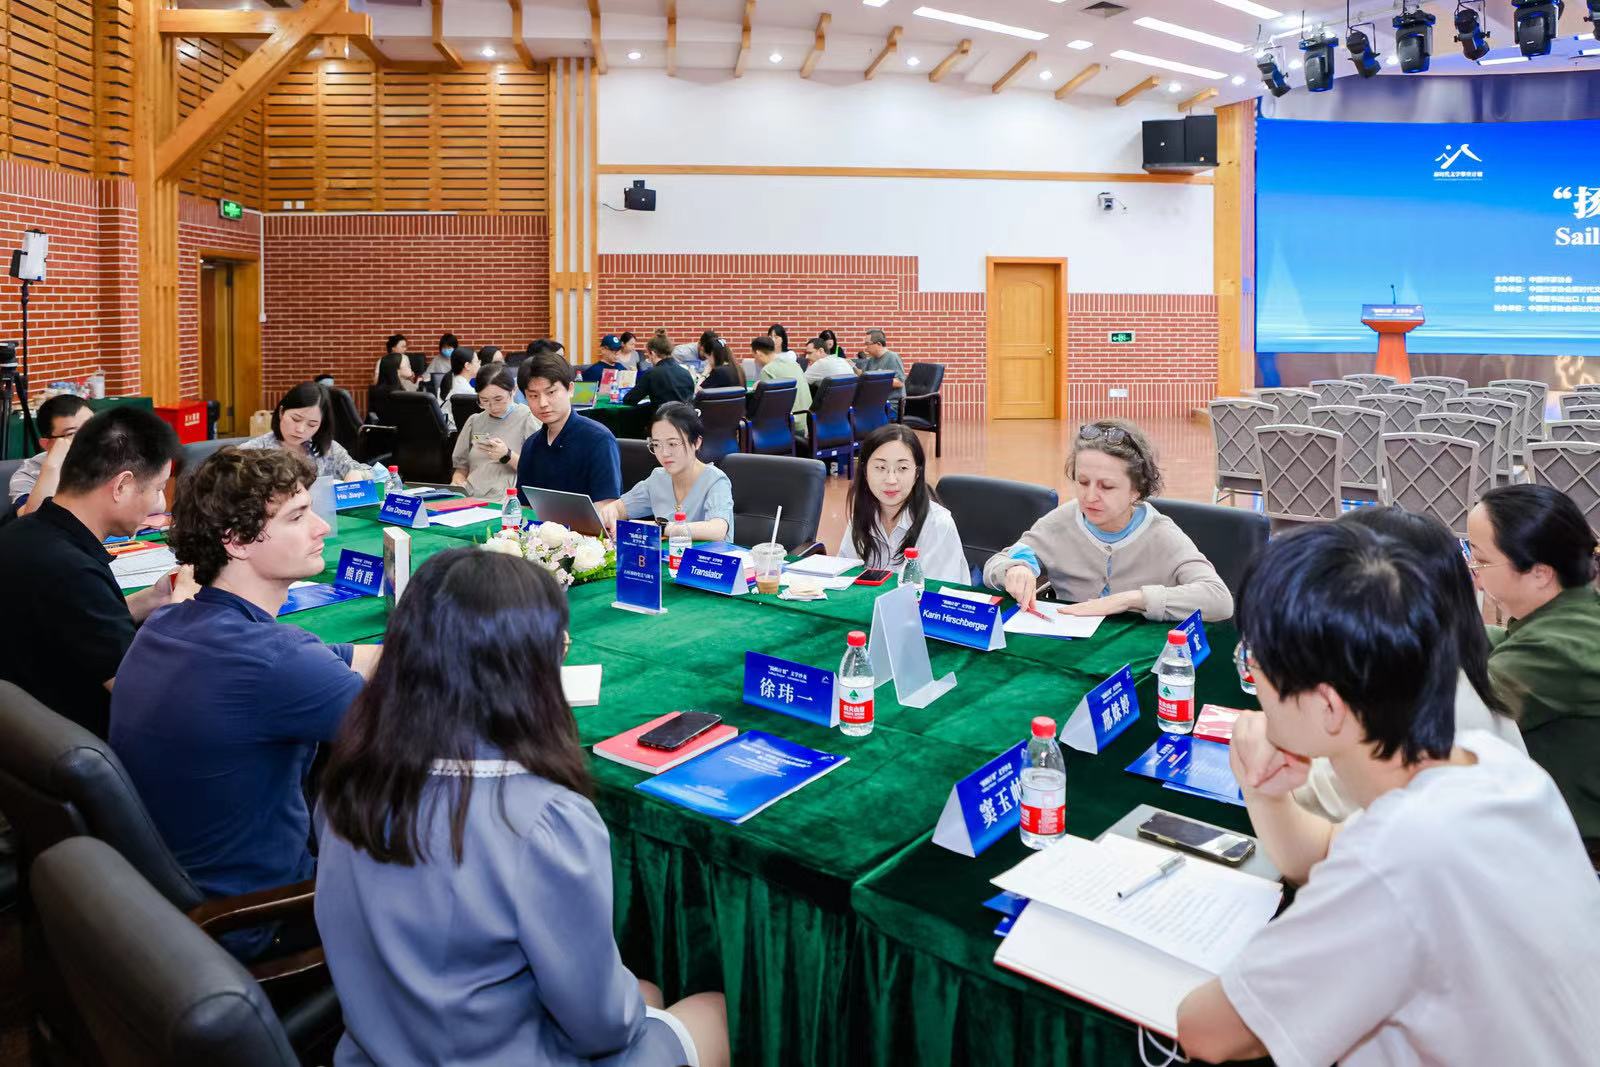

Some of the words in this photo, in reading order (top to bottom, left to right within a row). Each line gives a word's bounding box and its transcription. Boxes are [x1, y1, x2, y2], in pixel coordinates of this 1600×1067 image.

[690, 565, 724, 580] Translator
[922, 609, 942, 622] Karin
[942, 612, 988, 632] Hirschberger
[759, 677, 814, 704] 徐玮一
